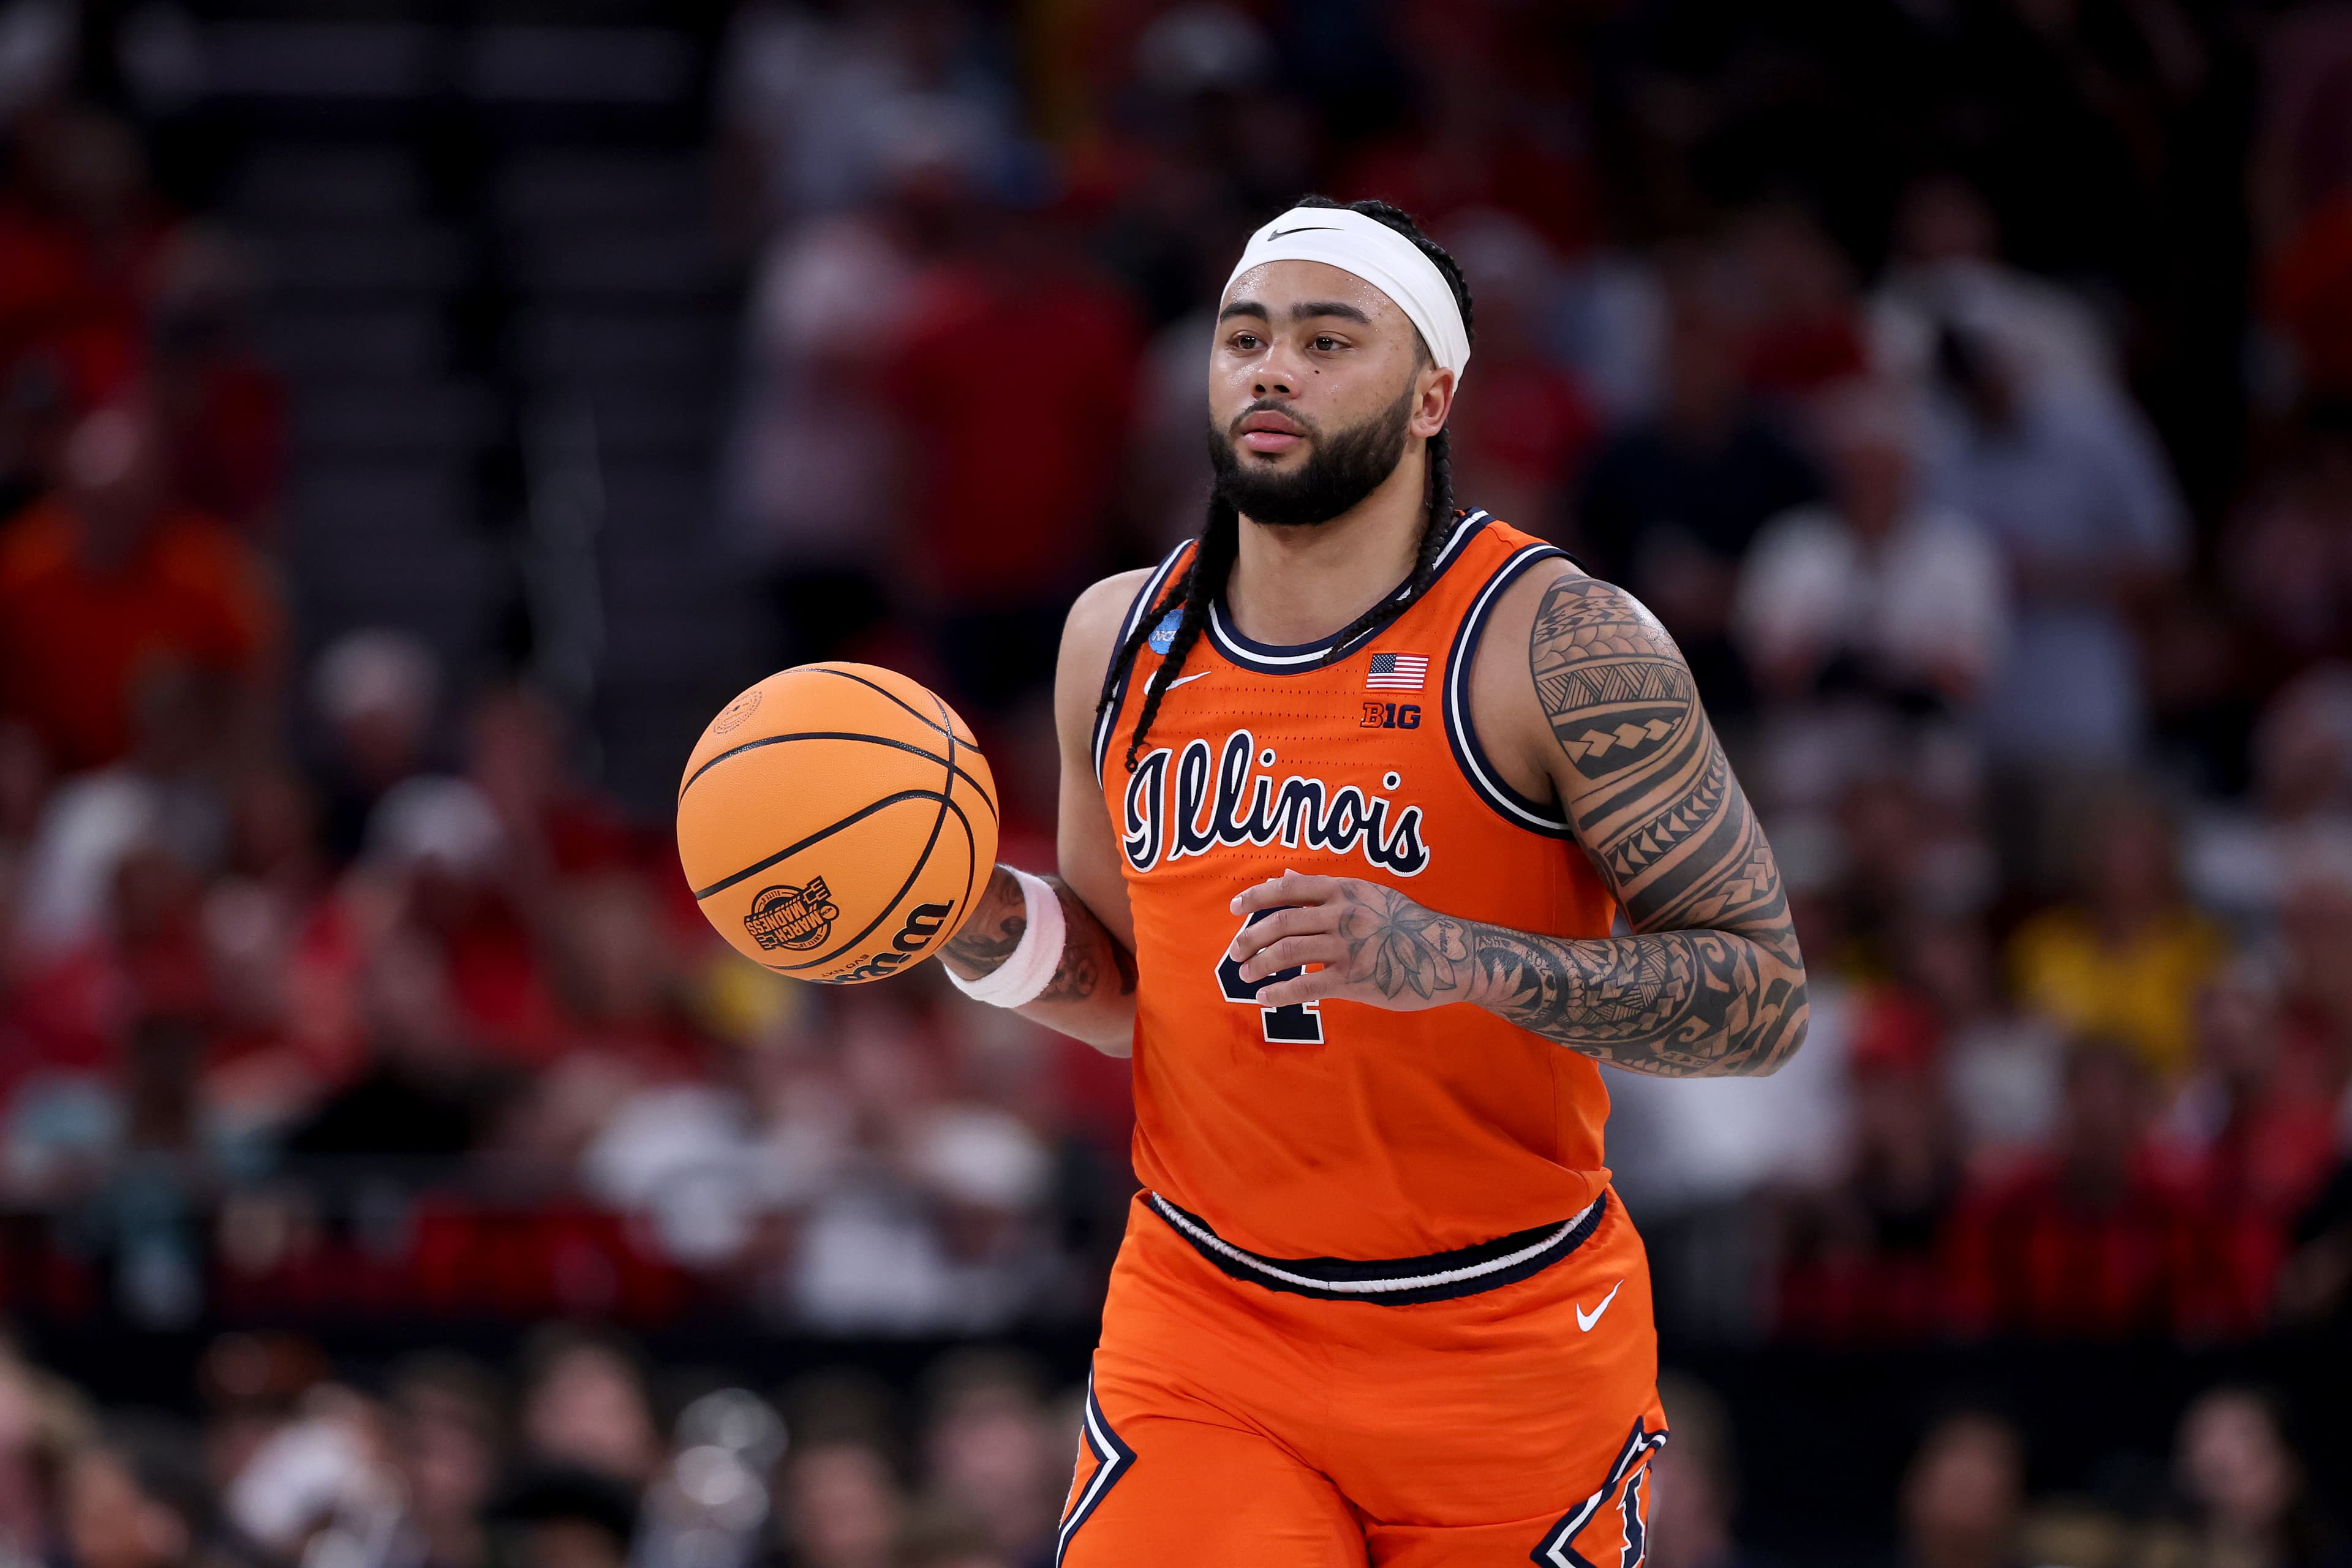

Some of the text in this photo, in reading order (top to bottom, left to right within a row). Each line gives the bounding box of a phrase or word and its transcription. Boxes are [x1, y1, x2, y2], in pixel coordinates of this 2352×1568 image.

[1122, 729, 1430, 877] Illinois
[745, 902, 807, 935] MADNESS
[774, 911, 823, 942] MARCH
[846, 954, 870, 969] EVO
